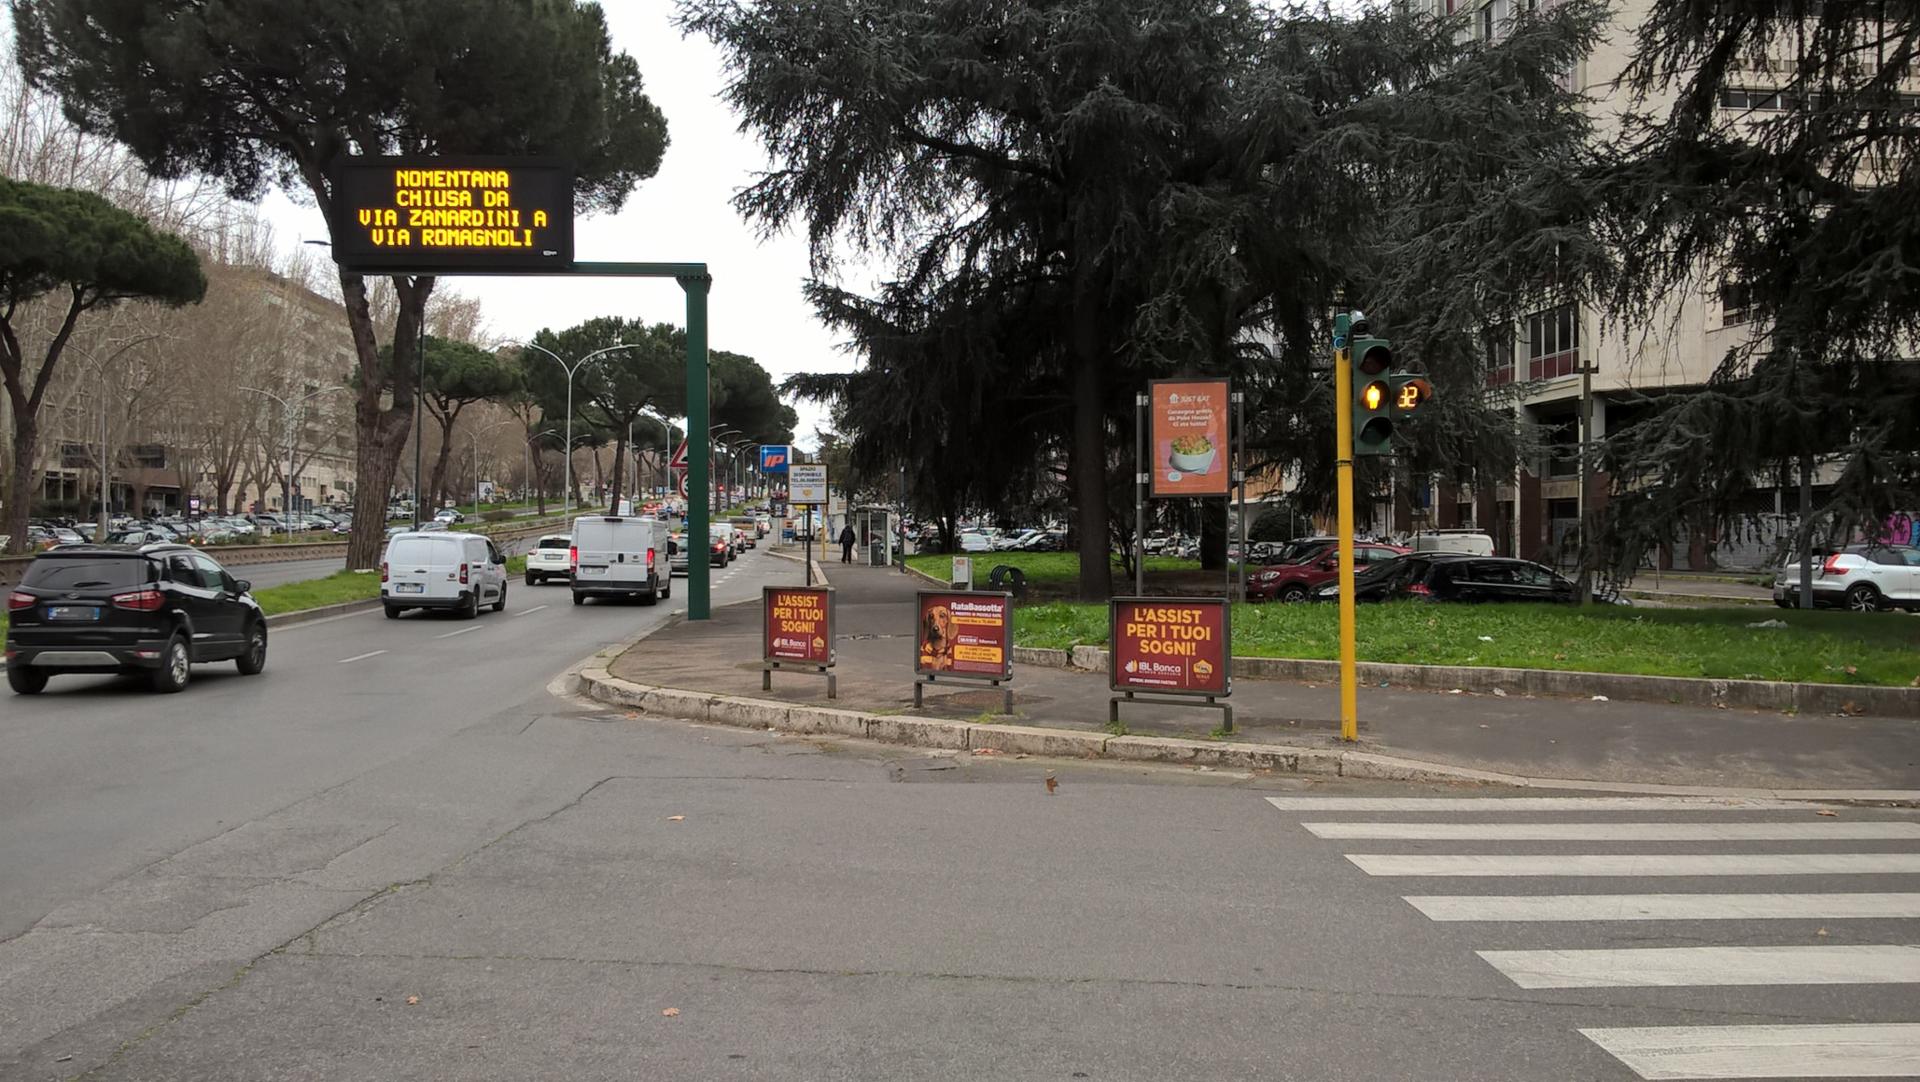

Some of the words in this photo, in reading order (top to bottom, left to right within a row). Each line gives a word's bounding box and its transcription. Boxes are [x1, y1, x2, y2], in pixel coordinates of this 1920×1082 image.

[396, 170, 509, 188] NOMENTANA
[396, 190, 472, 207] CHIUSA
[483, 190, 509, 208] DA
[359, 209, 398, 227] VIA
[409, 209, 520, 227] ZANARDINI
[534, 210, 547, 228] A
[371, 229, 411, 246] VIA
[422, 229, 533, 247] ROMAGNOLI
[1398, 386, 1418, 408] 32
[764, 455, 785, 467] IP
[778, 595, 818, 607] L'ASSIST
[773, 608, 792, 619] PER
[793, 608, 797, 619] I
[799, 609, 823, 621] TUOI
[1134, 607, 1203, 624] L'ASSIST
[781, 620, 815, 633] SOGNI!
[1127, 623, 1157, 638] PER
[1161, 624, 1166, 639] I
[1170, 625, 1211, 641] TUOI
[1140, 639, 1197, 656] SOGNI!
[1139, 661, 1152, 671] IBL
[1153, 662, 1182, 673] Banca
